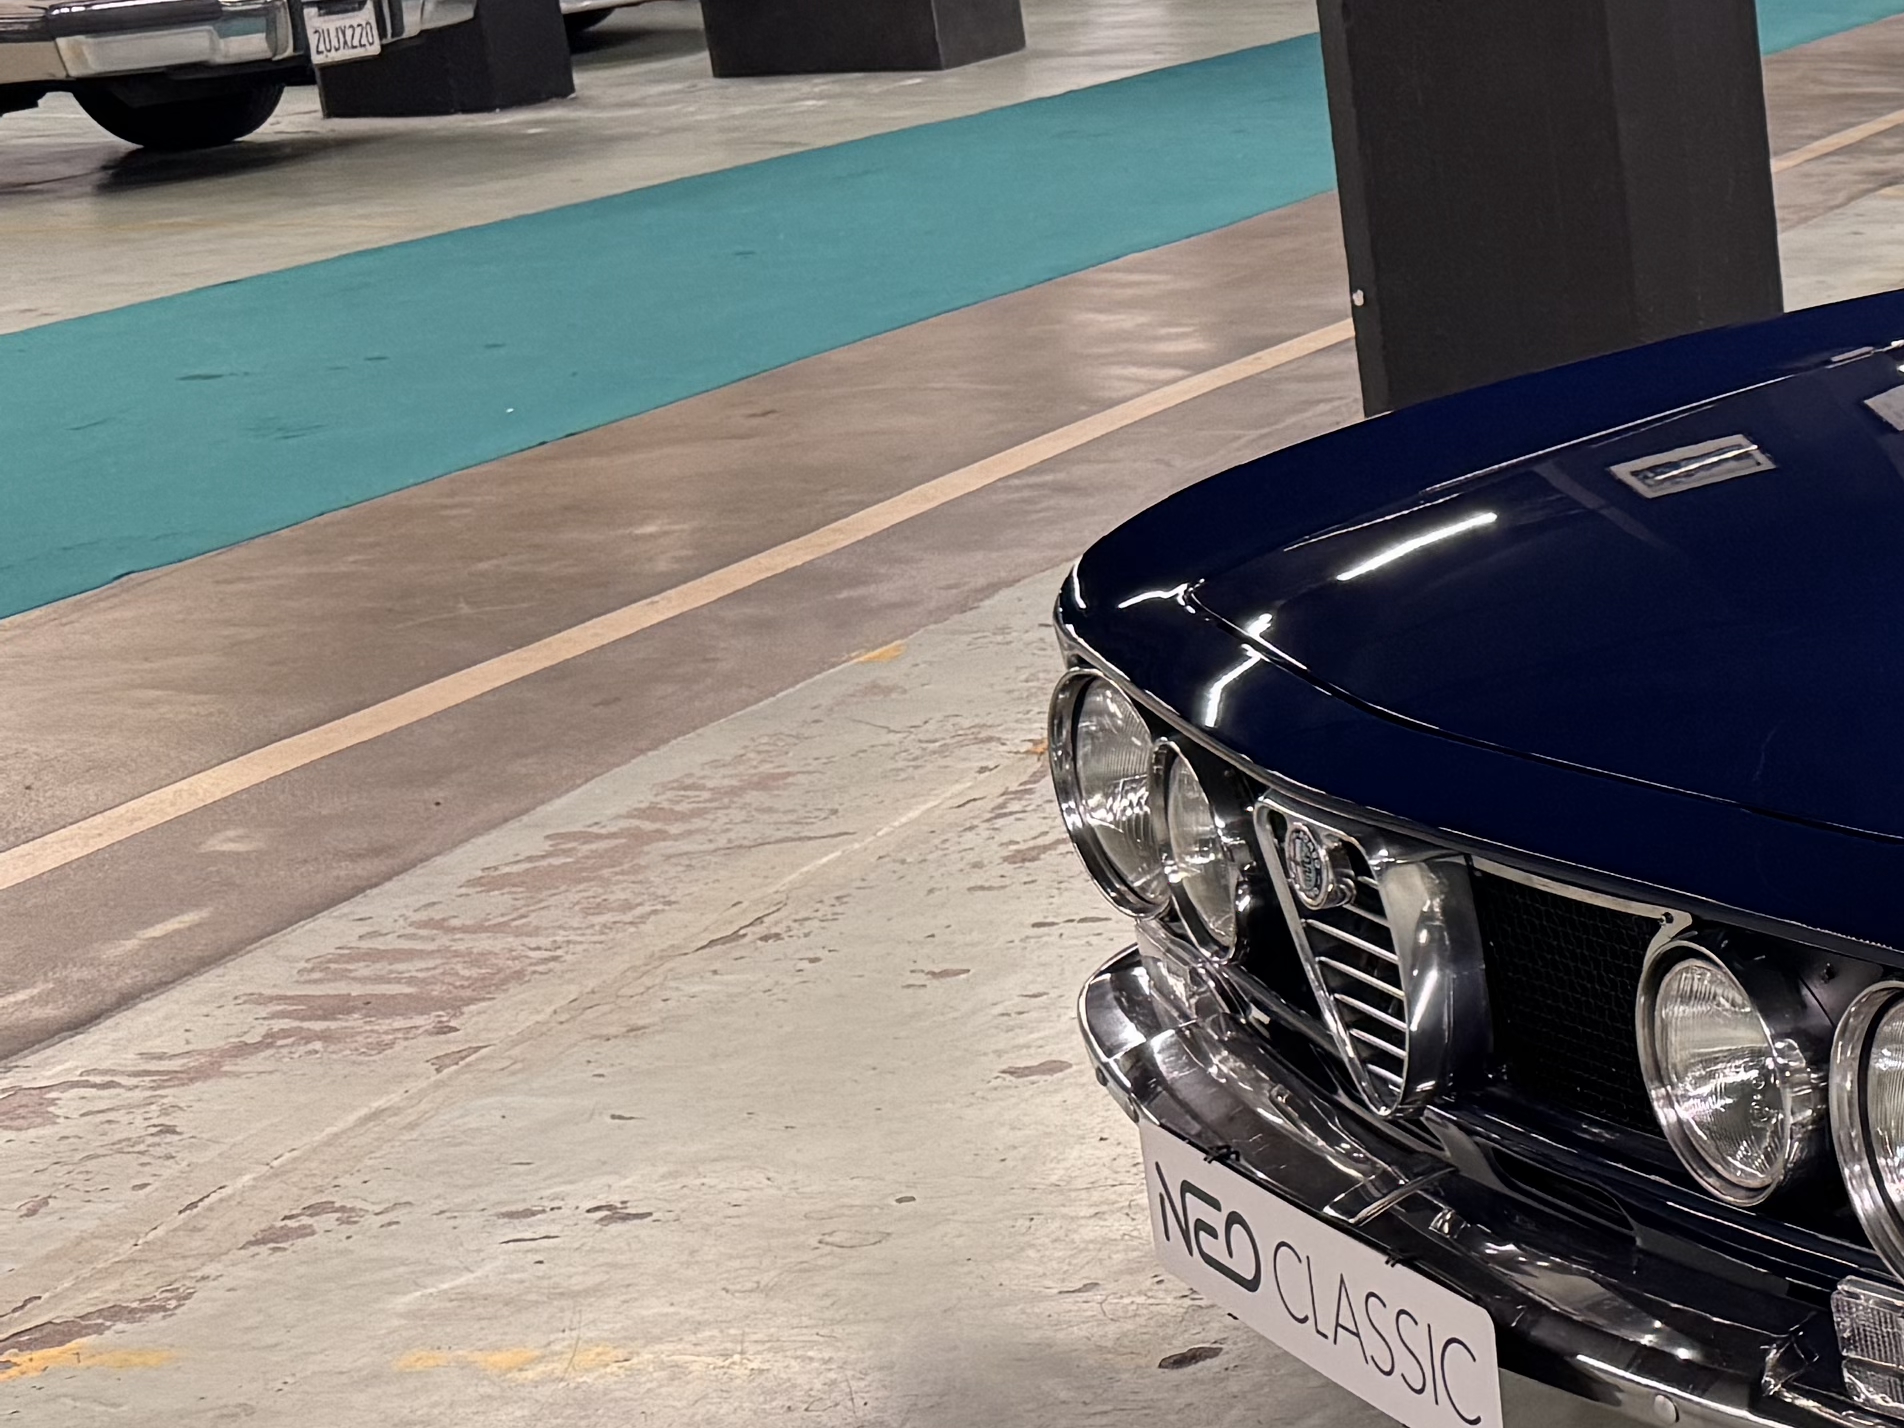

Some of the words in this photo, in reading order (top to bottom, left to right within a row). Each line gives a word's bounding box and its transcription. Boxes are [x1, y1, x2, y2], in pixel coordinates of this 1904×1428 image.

[313, 20, 376, 57] 2UJX220
[1155, 1160, 1262, 1293] NEO
[1273, 1240, 1482, 1426] CLASSIC
